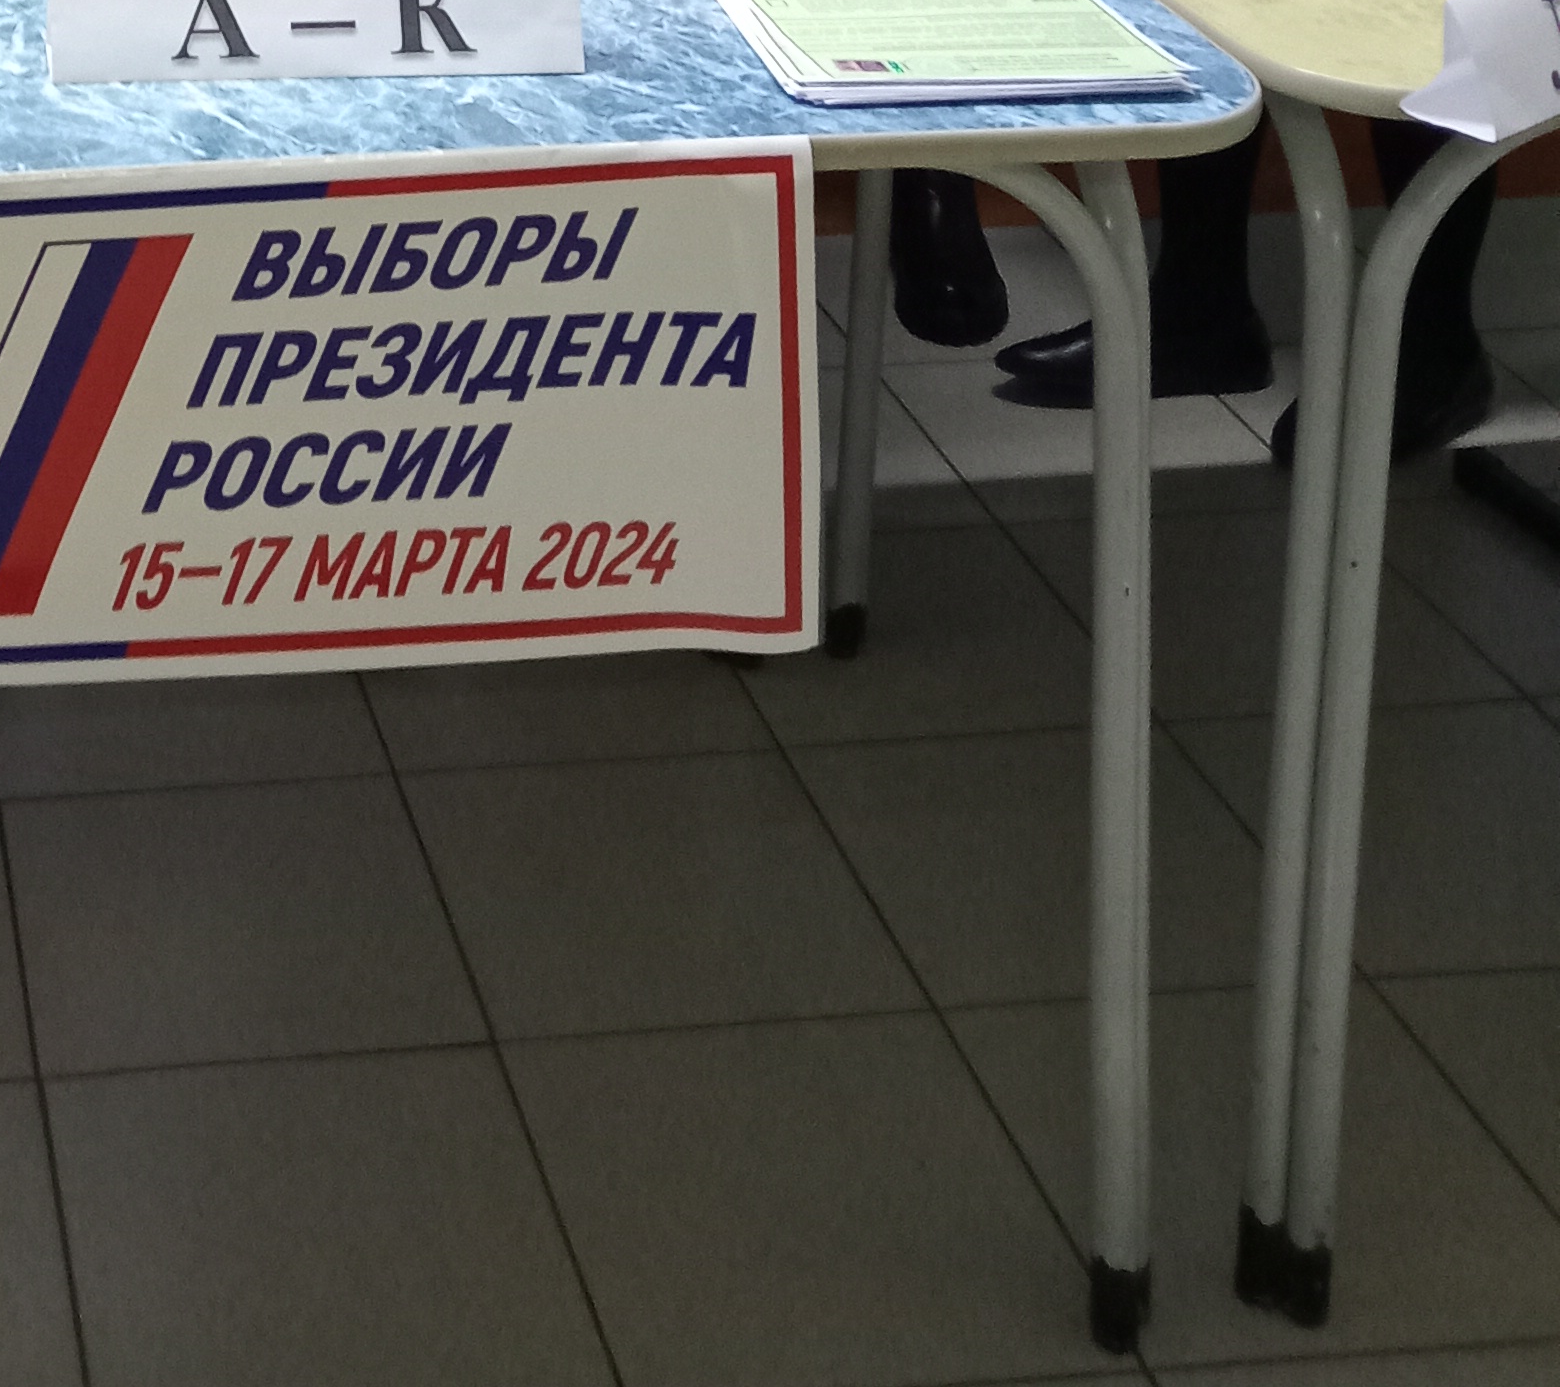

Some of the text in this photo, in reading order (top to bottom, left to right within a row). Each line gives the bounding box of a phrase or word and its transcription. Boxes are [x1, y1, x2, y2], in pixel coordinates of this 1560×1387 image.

[231, 206, 638, 304] ВЫБОРЫ
[187, 311, 757, 409] ПРЕЗИДЕНТА
[141, 422, 512, 514] РОССИИ
[294, 524, 509, 604] МАРТА
[520, 519, 677, 593] 2024
